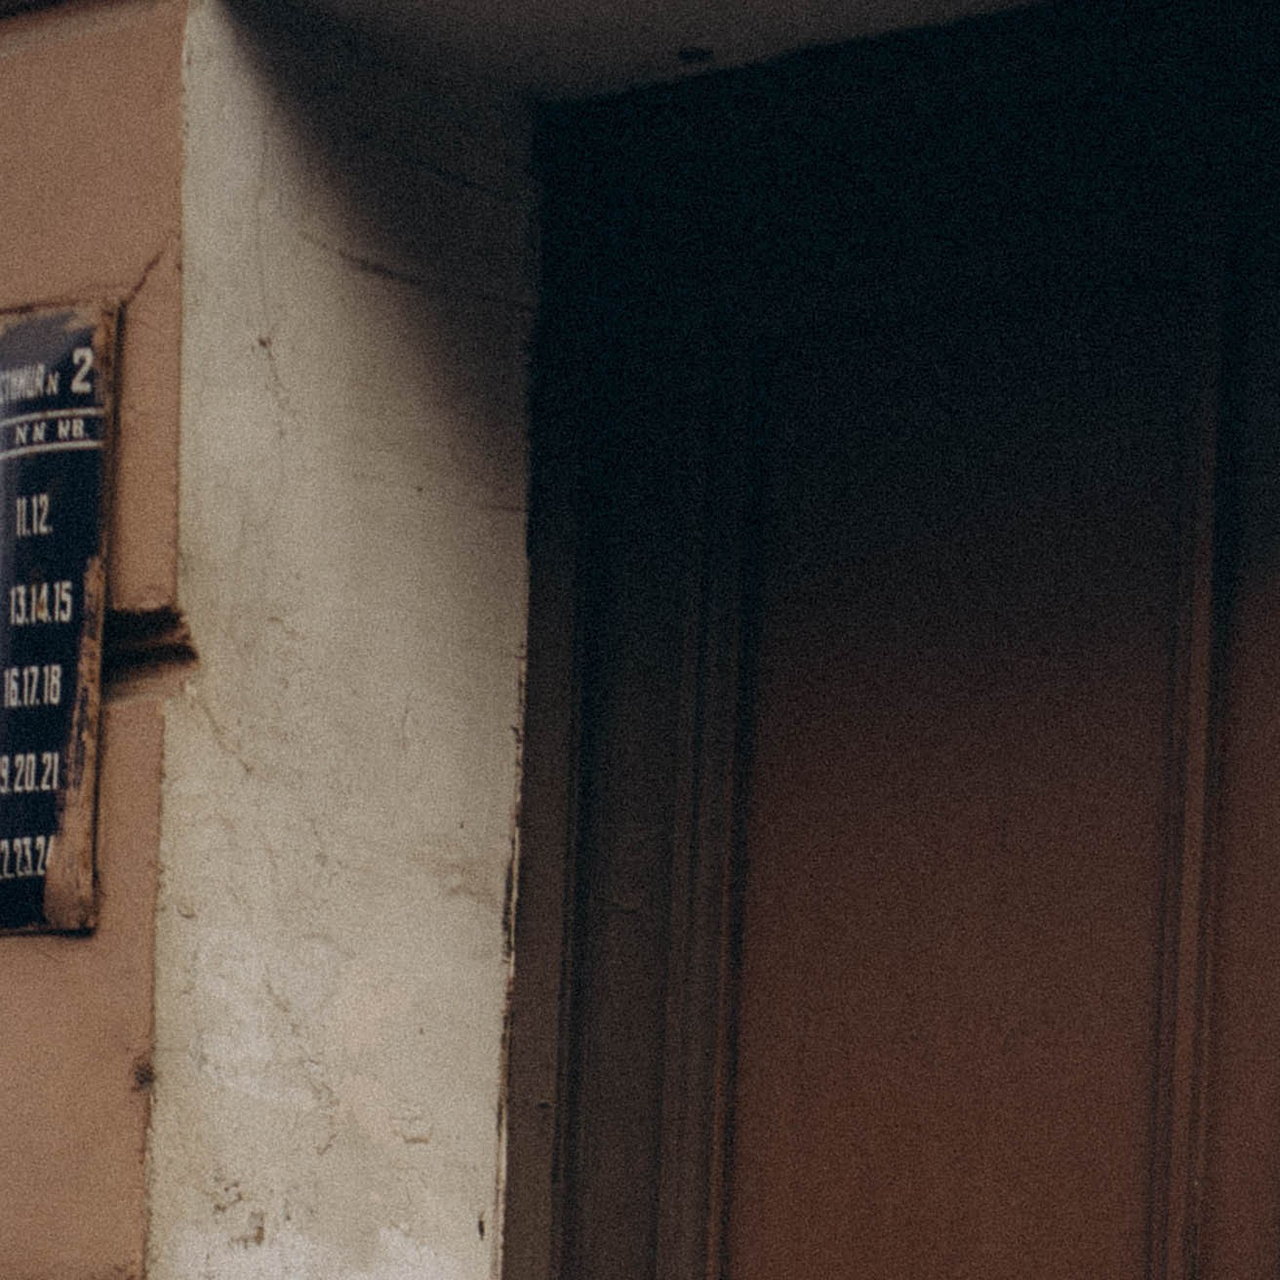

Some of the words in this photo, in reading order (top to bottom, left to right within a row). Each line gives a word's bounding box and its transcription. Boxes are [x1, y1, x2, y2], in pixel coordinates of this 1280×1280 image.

[71, 347, 93, 393] 2
[10, 580, 73, 624] 13.14.15
[4, 665, 61, 708] 16.17.18
